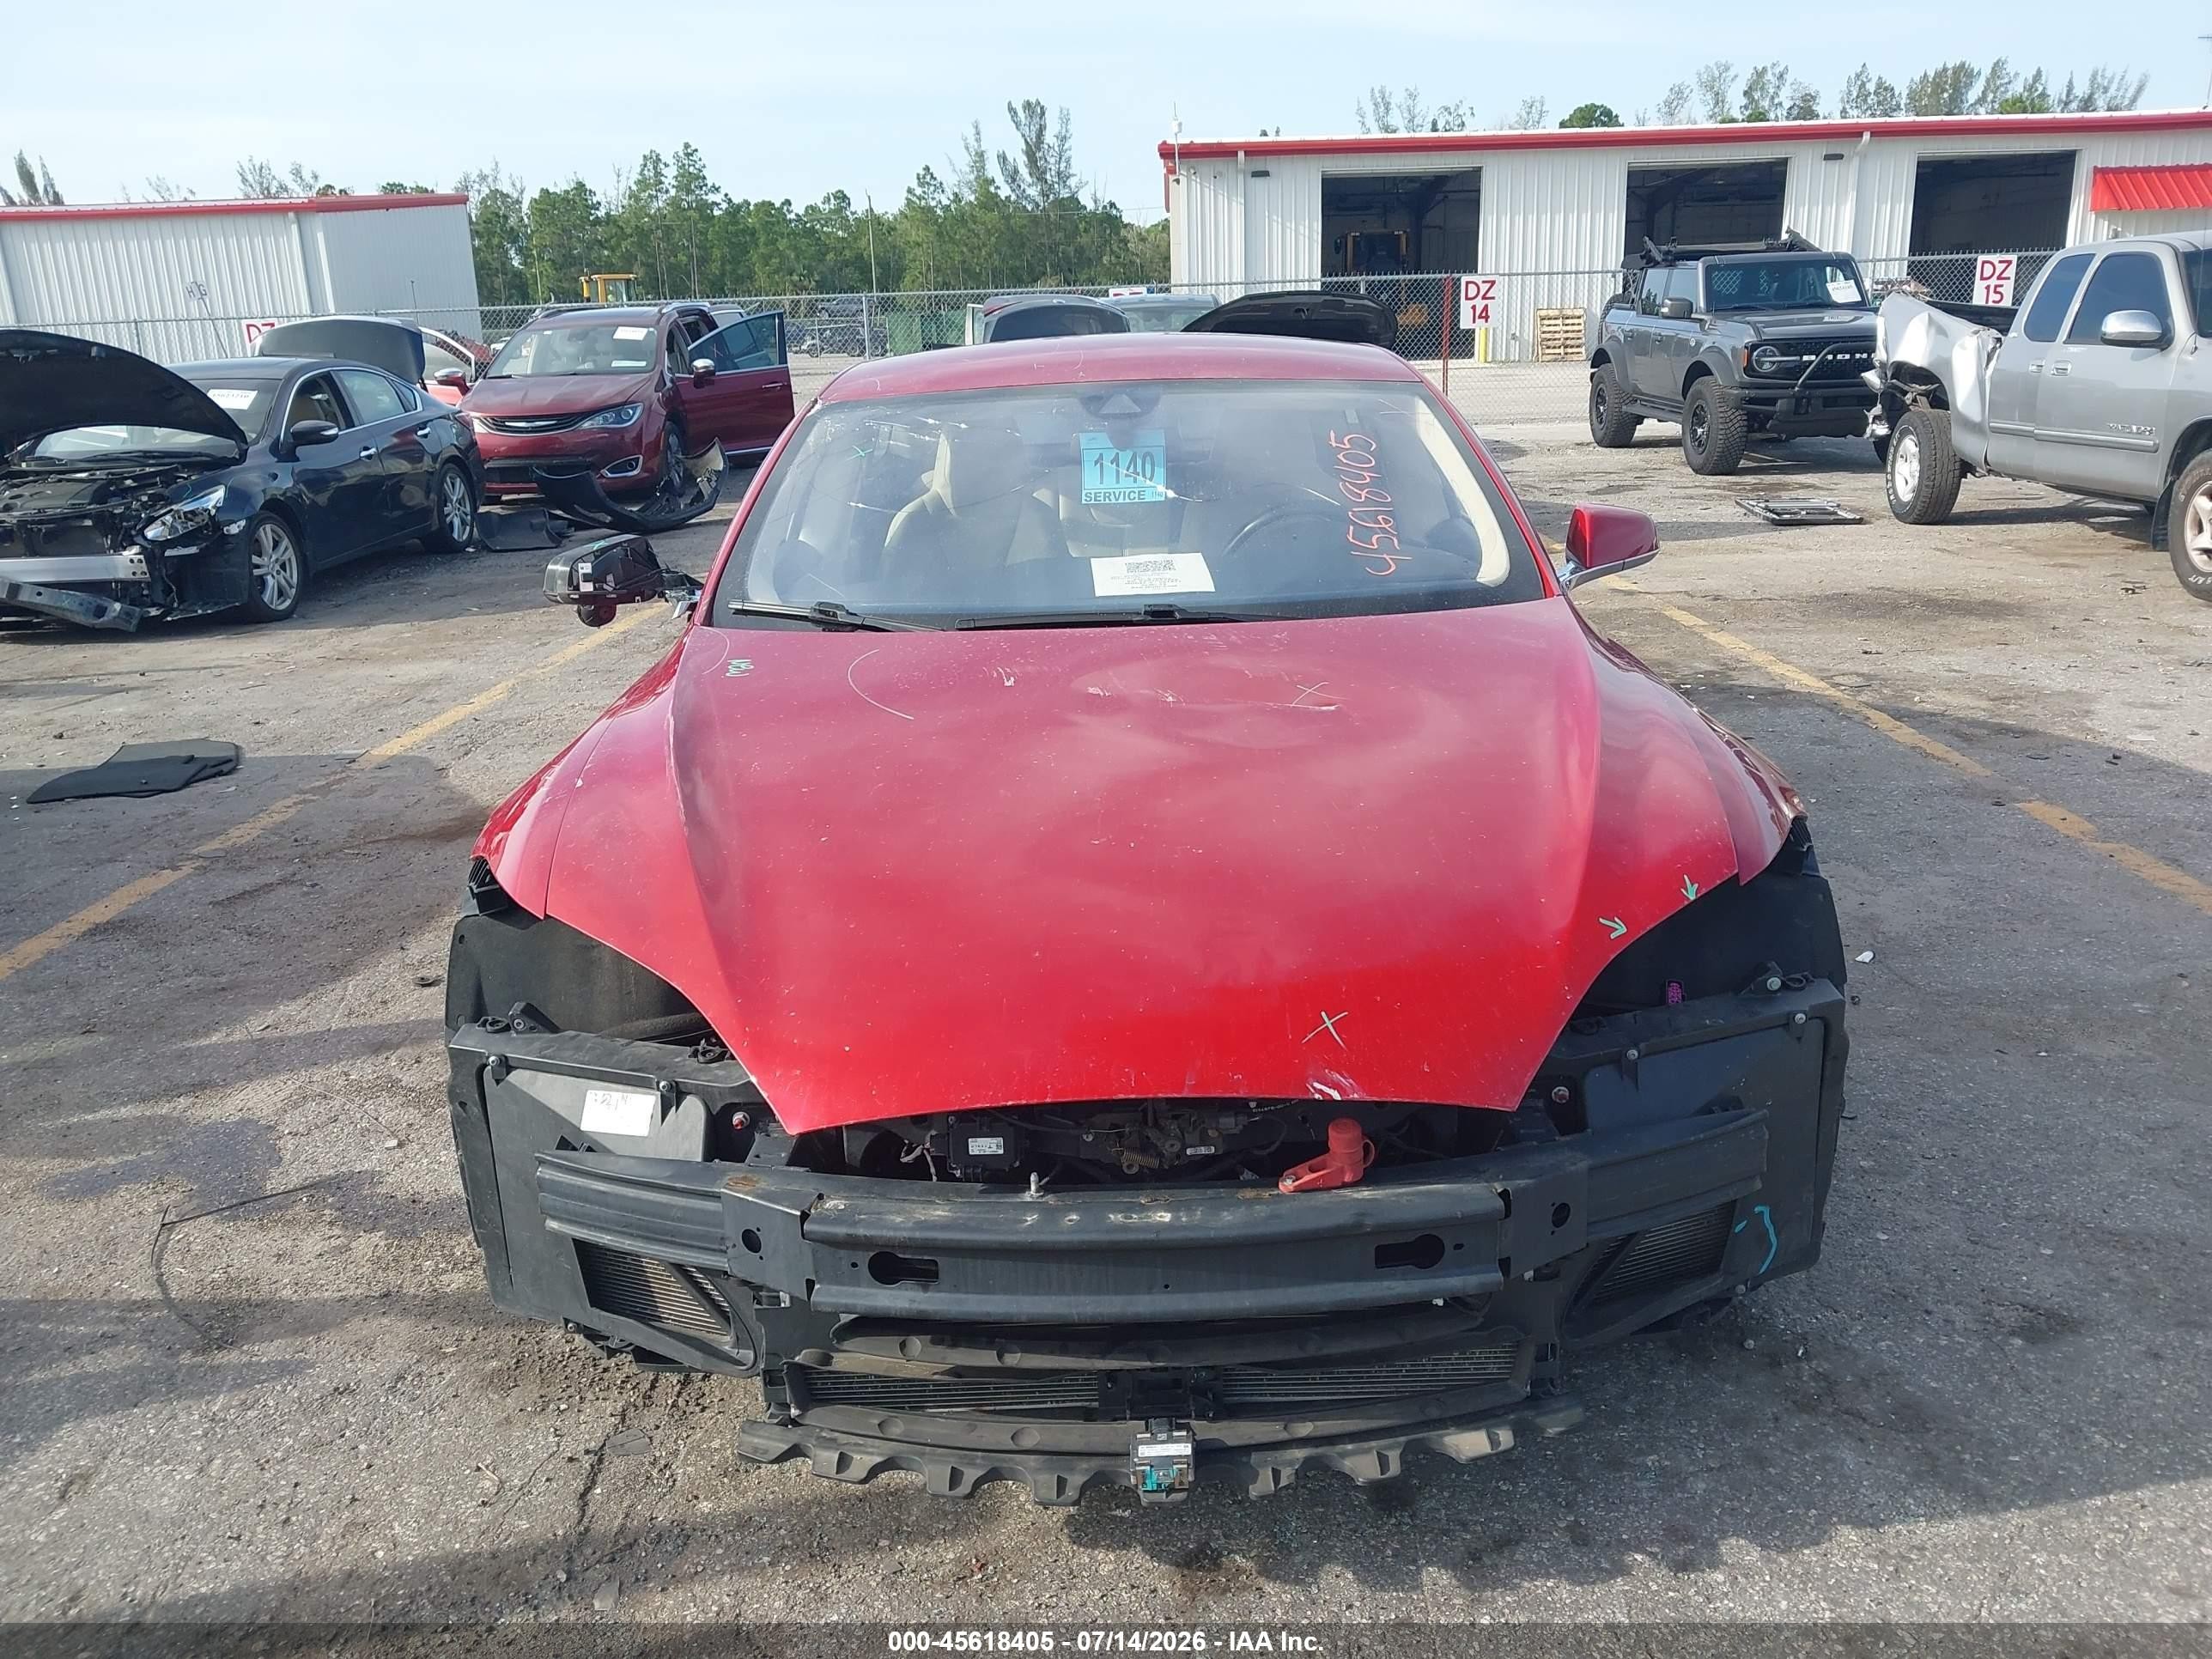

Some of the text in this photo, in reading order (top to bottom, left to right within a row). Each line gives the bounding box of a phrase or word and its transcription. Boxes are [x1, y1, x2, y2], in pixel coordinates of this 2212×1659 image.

[1980, 260, 2013, 281] DZ
[1465, 280, 1496, 301] DZ
[1984, 284, 2004, 304] 15
[1471, 304, 1490, 324] 14
[1094, 452, 1156, 484] 1140
[1084, 490, 1146, 502] SERVICE
[1329, 429, 1413, 576] 45618405
